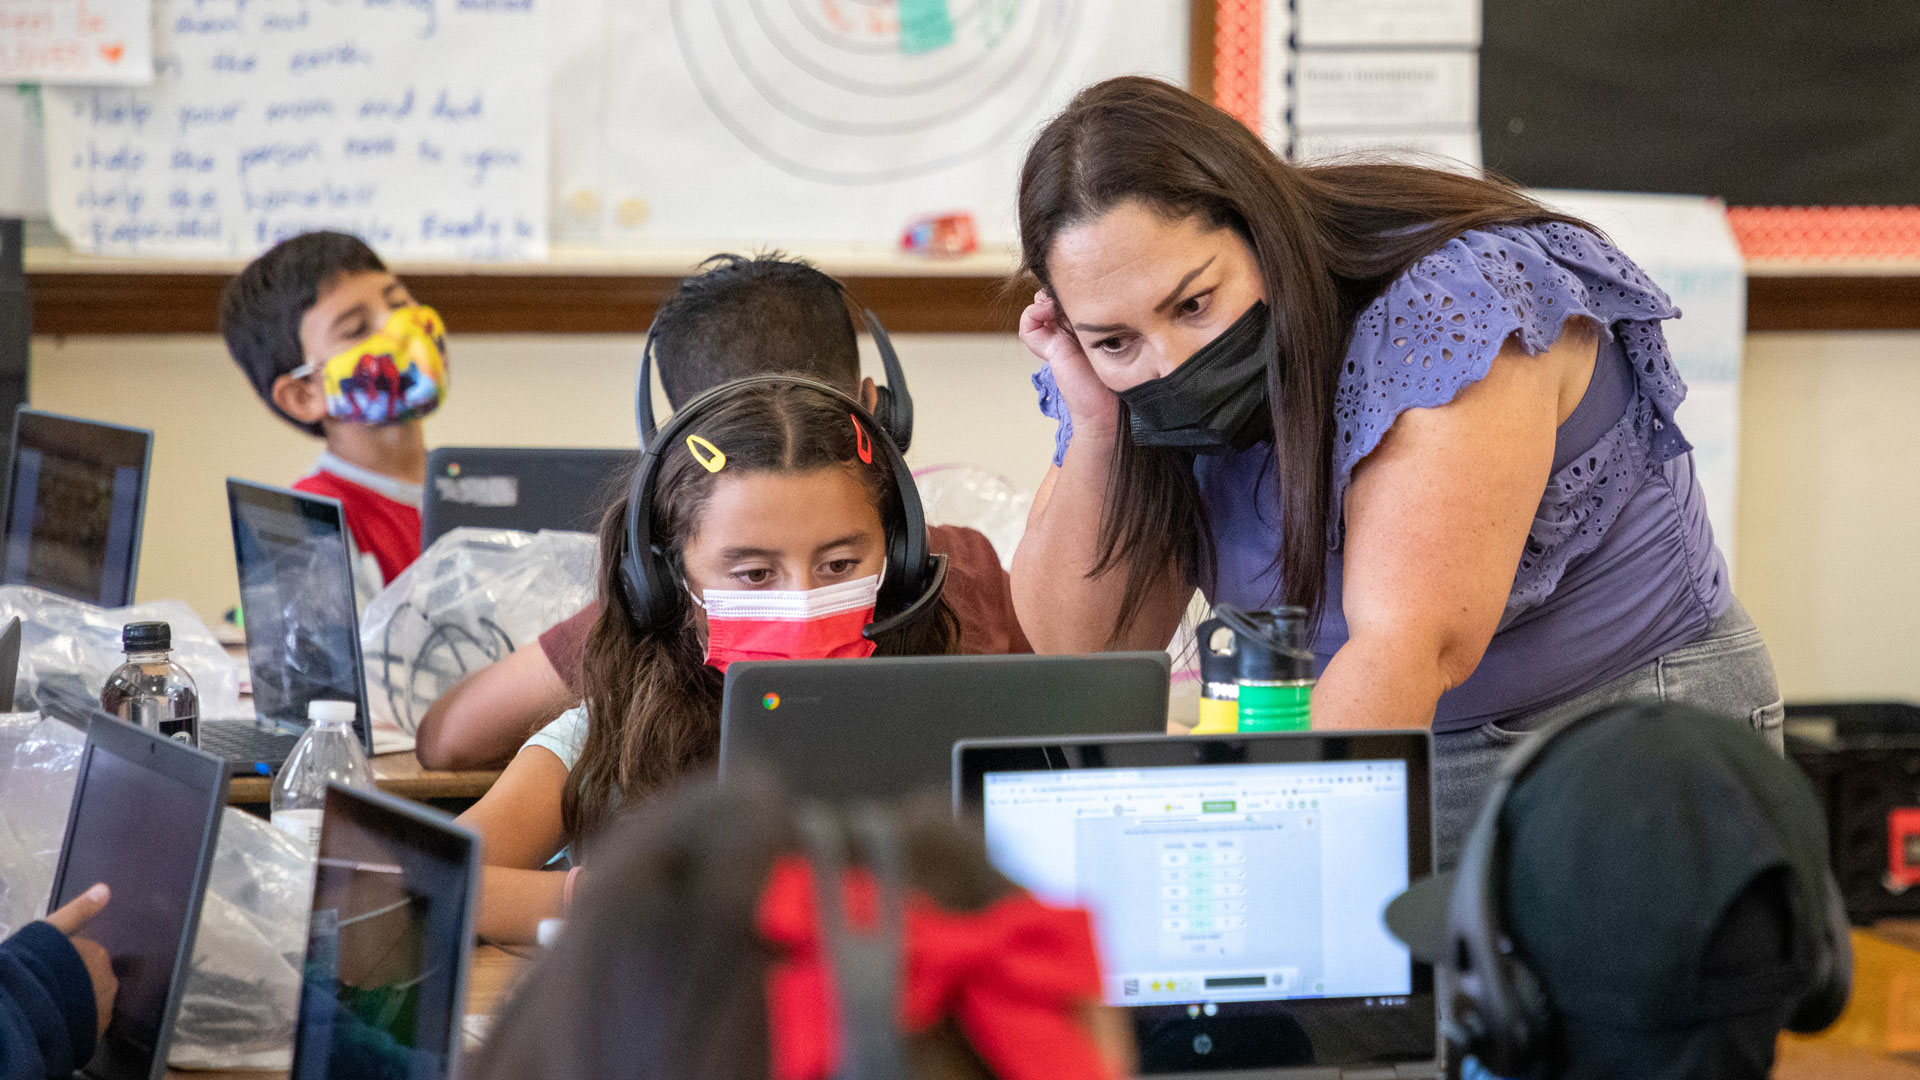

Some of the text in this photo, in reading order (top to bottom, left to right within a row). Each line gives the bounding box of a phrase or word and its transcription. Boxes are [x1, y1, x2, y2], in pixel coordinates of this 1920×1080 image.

[91, 93, 151, 129] help
[358, 87, 415, 119] and
[88, 139, 145, 174] help
